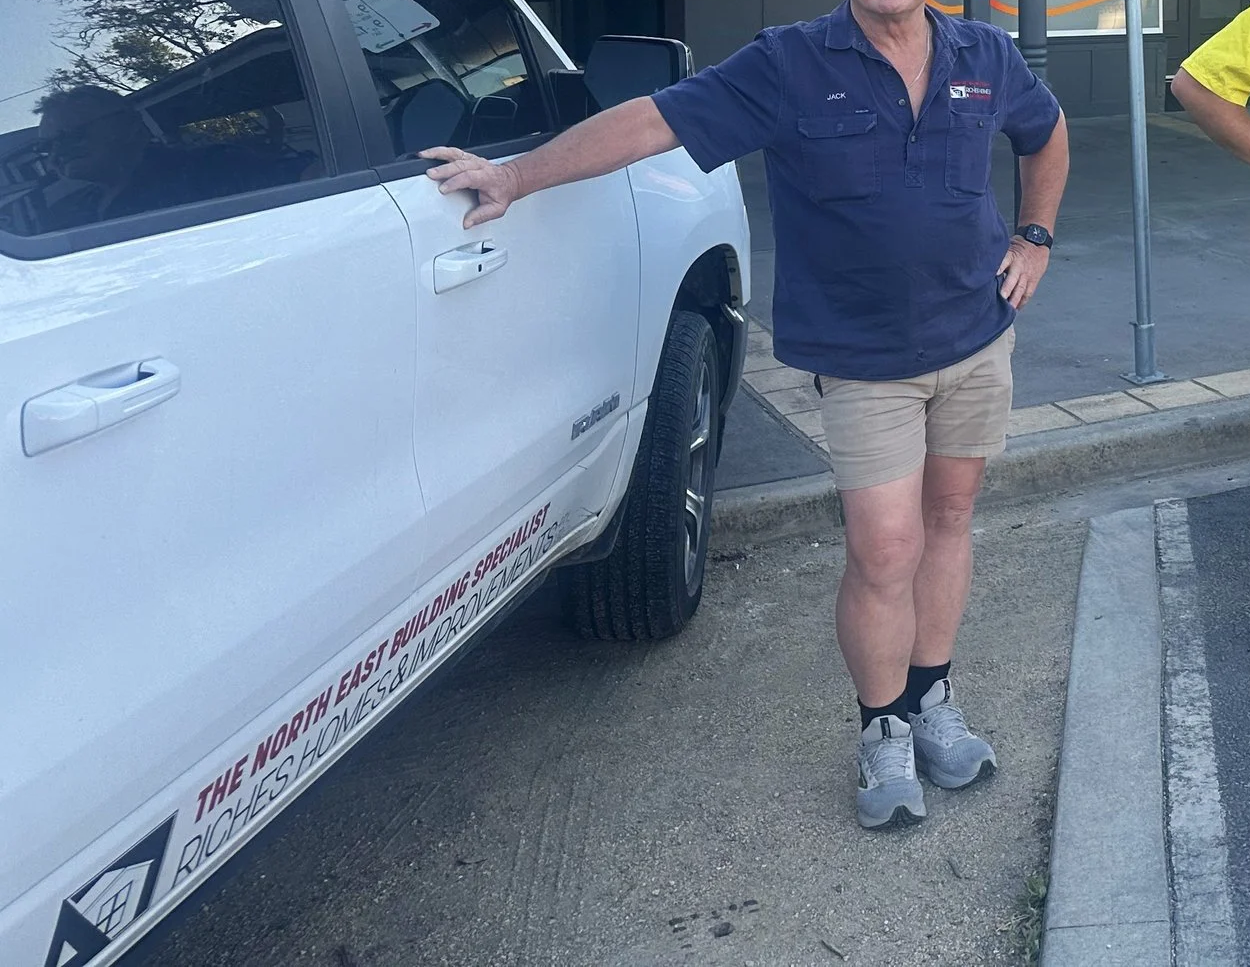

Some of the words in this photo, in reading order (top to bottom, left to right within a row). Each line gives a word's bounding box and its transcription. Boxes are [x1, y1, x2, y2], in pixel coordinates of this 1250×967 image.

[827, 92, 846, 100] JACK
[173, 754, 294, 890] RICHES
[295, 669, 392, 779] HOMES
[408, 521, 558, 678] IMPROVEMENTS
[195, 753, 249, 825] THE
[250, 684, 333, 778] NORTH
[334, 639, 389, 708] EAST
[388, 571, 471, 661] BUILDING
[471, 501, 551, 587] SPECIALIST
